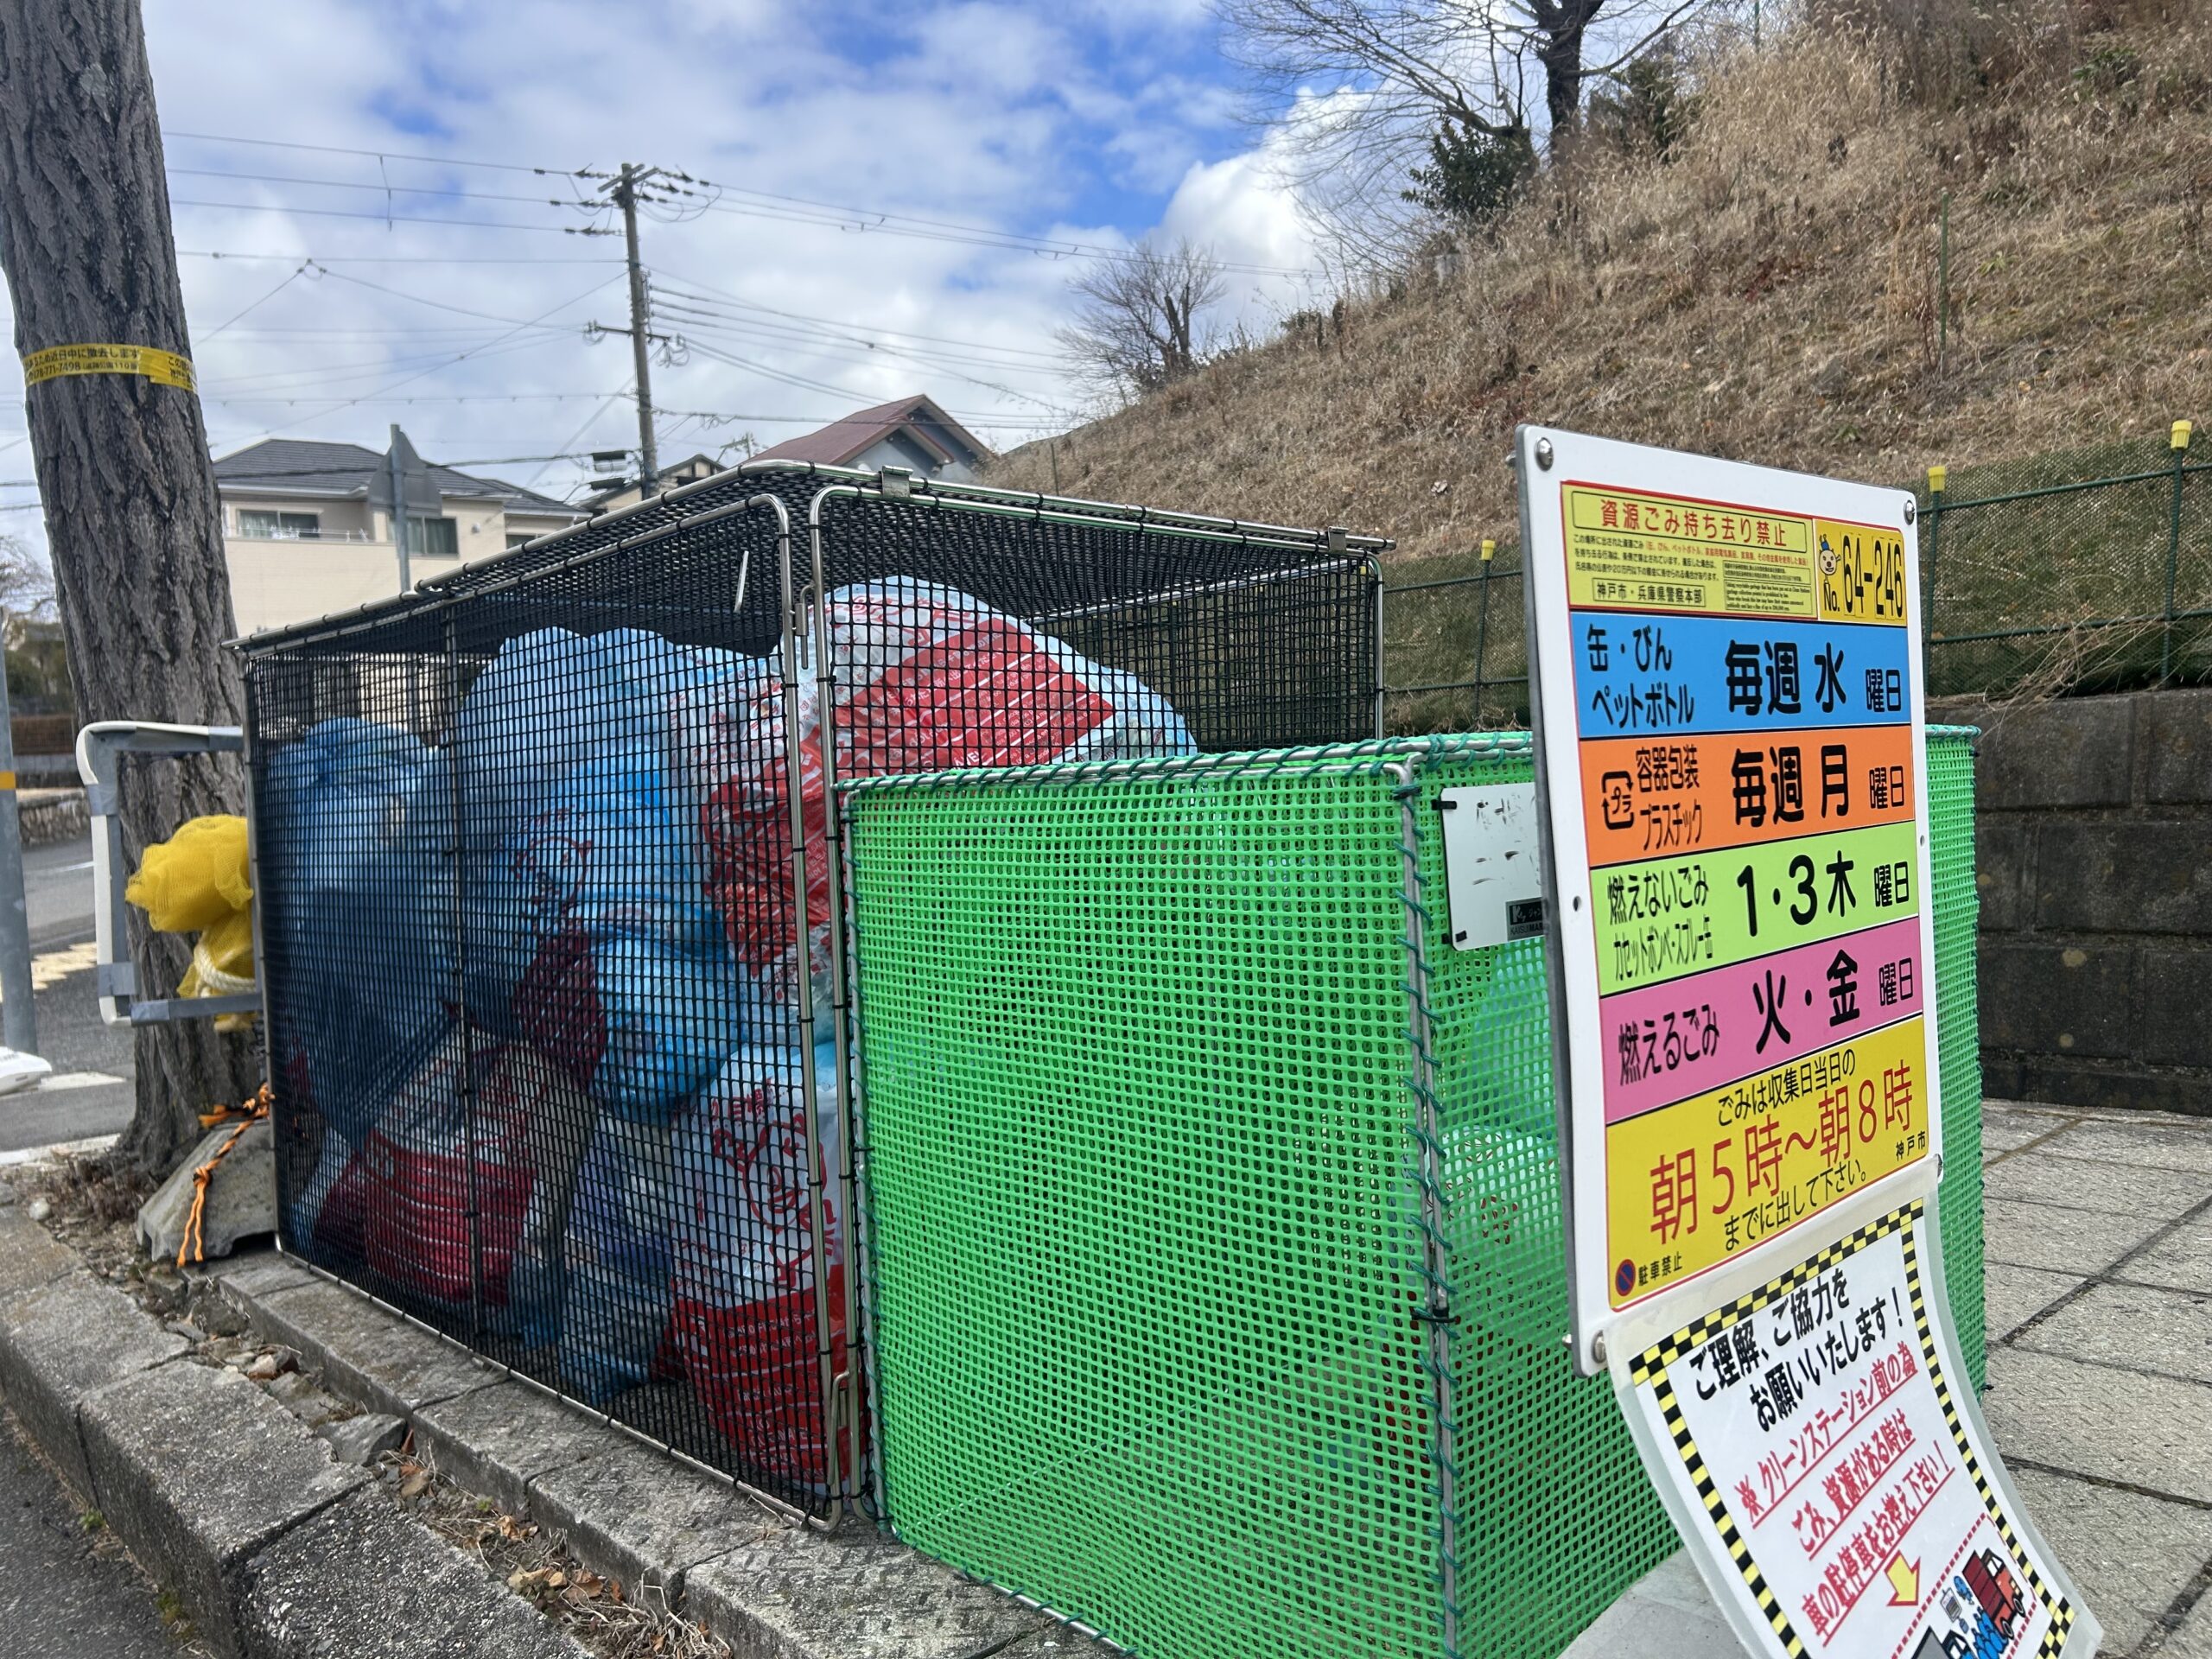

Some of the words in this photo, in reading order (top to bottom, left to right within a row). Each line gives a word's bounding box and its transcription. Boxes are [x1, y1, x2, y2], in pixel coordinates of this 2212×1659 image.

[1600, 499, 1787, 547] 資源ごみ持ち去り禁止
[1597, 582, 1702, 604] 神戸市・兵庫県警察本部
[1843, 534, 1903, 617] 64-246
[1587, 623, 1672, 672] 缶・びん
[1725, 639, 1802, 715] 毎週
[1815, 642, 1847, 713] 水
[1866, 669, 1902, 712] 曜日
[1592, 682, 1694, 728] ペットボトル
[1636, 745, 1700, 792] 容器包装
[1731, 746, 1804, 828] 毎週
[1821, 744, 1849, 818] 月
[1869, 766, 1904, 810] 曜日
[1611, 786, 1631, 814] プラ
[1640, 798, 1702, 851] プラスチック
[1607, 865, 1709, 926] 燃えないごみ
[1873, 861, 1910, 907] 曜日
[1879, 957, 1913, 1007] 曜日
[1618, 1003, 1720, 1086] 燃えるごみ
[1718, 1048, 1856, 1127] ごみは収集日当日の
[1896, 1130, 1926, 1161] 神戸市
[1724, 1159, 1867, 1251] までに出して下さい。
[1637, 1251, 1682, 1287] 駐車禁止
[1689, 1268, 1849, 1401] ご理解、ご協力を
[1791, 1408, 1916, 1554] ごみ、資源がある時は
